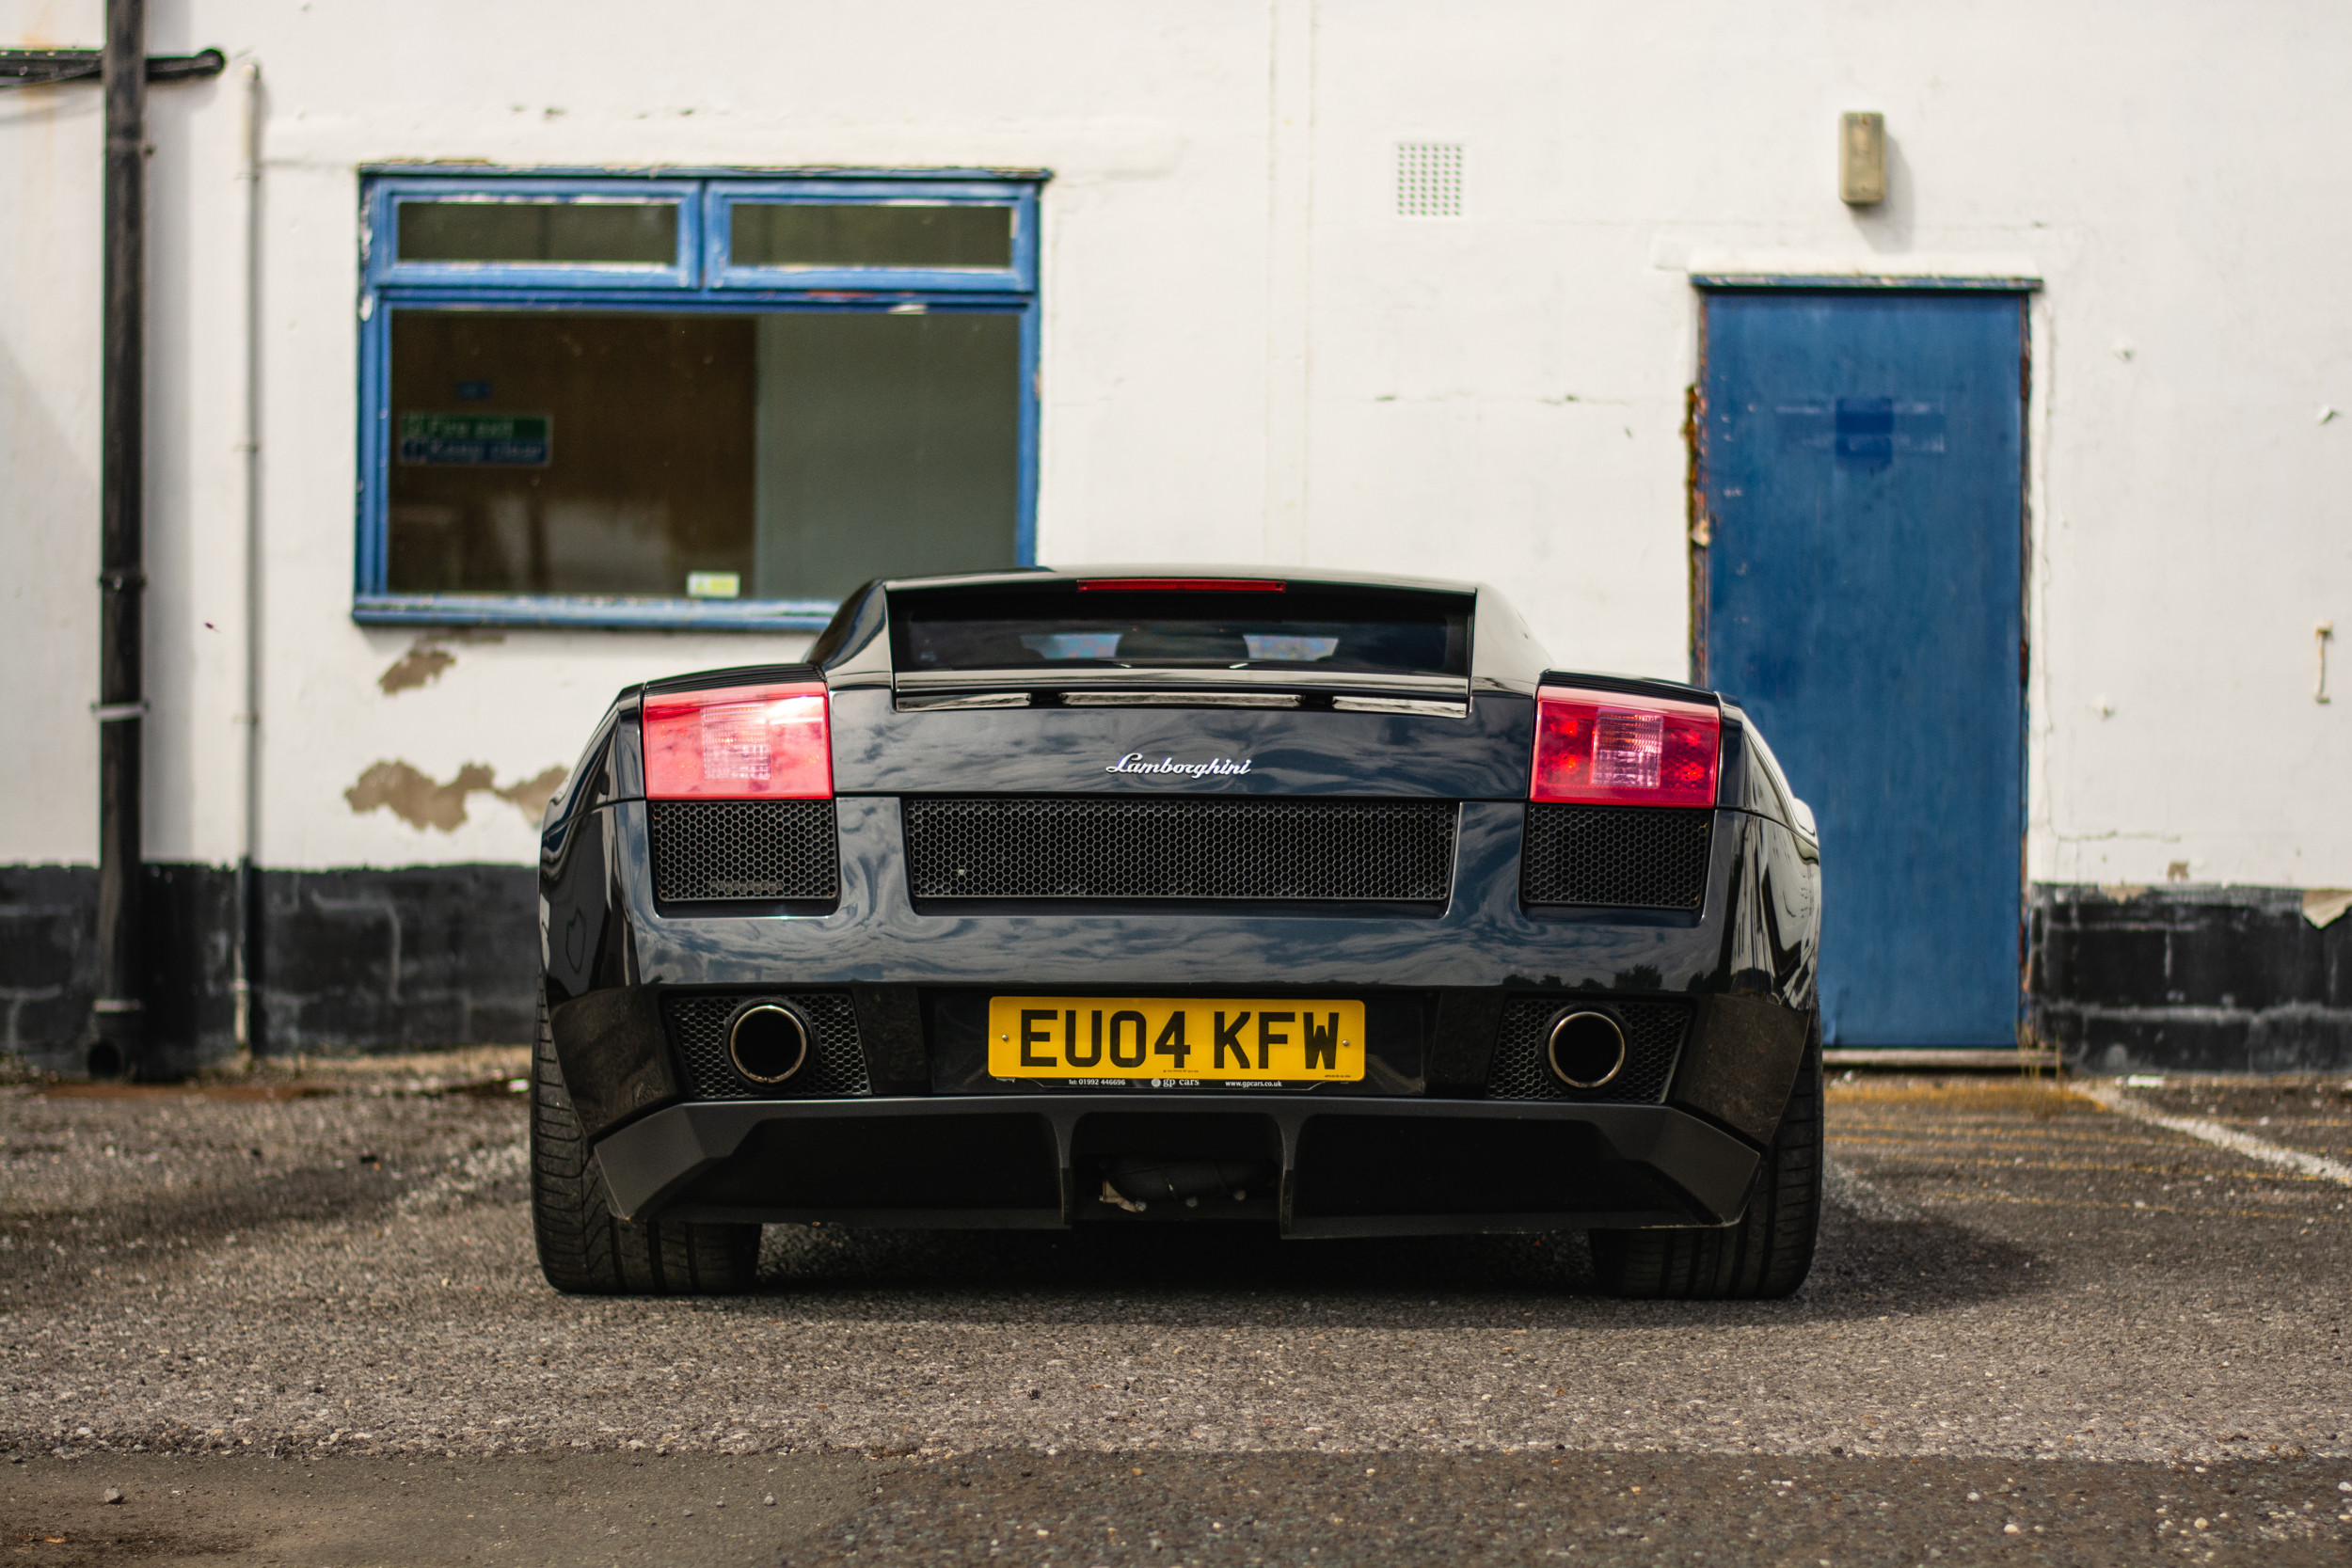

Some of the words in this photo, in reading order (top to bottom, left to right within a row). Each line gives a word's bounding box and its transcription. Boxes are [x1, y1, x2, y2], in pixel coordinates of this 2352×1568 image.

[1105, 752, 1252, 779] Lamborghini
[1021, 1009, 1191, 1069] EU04
[1214, 1011, 1340, 1070] KFW
[1162, 1078, 1176, 1087] gp
